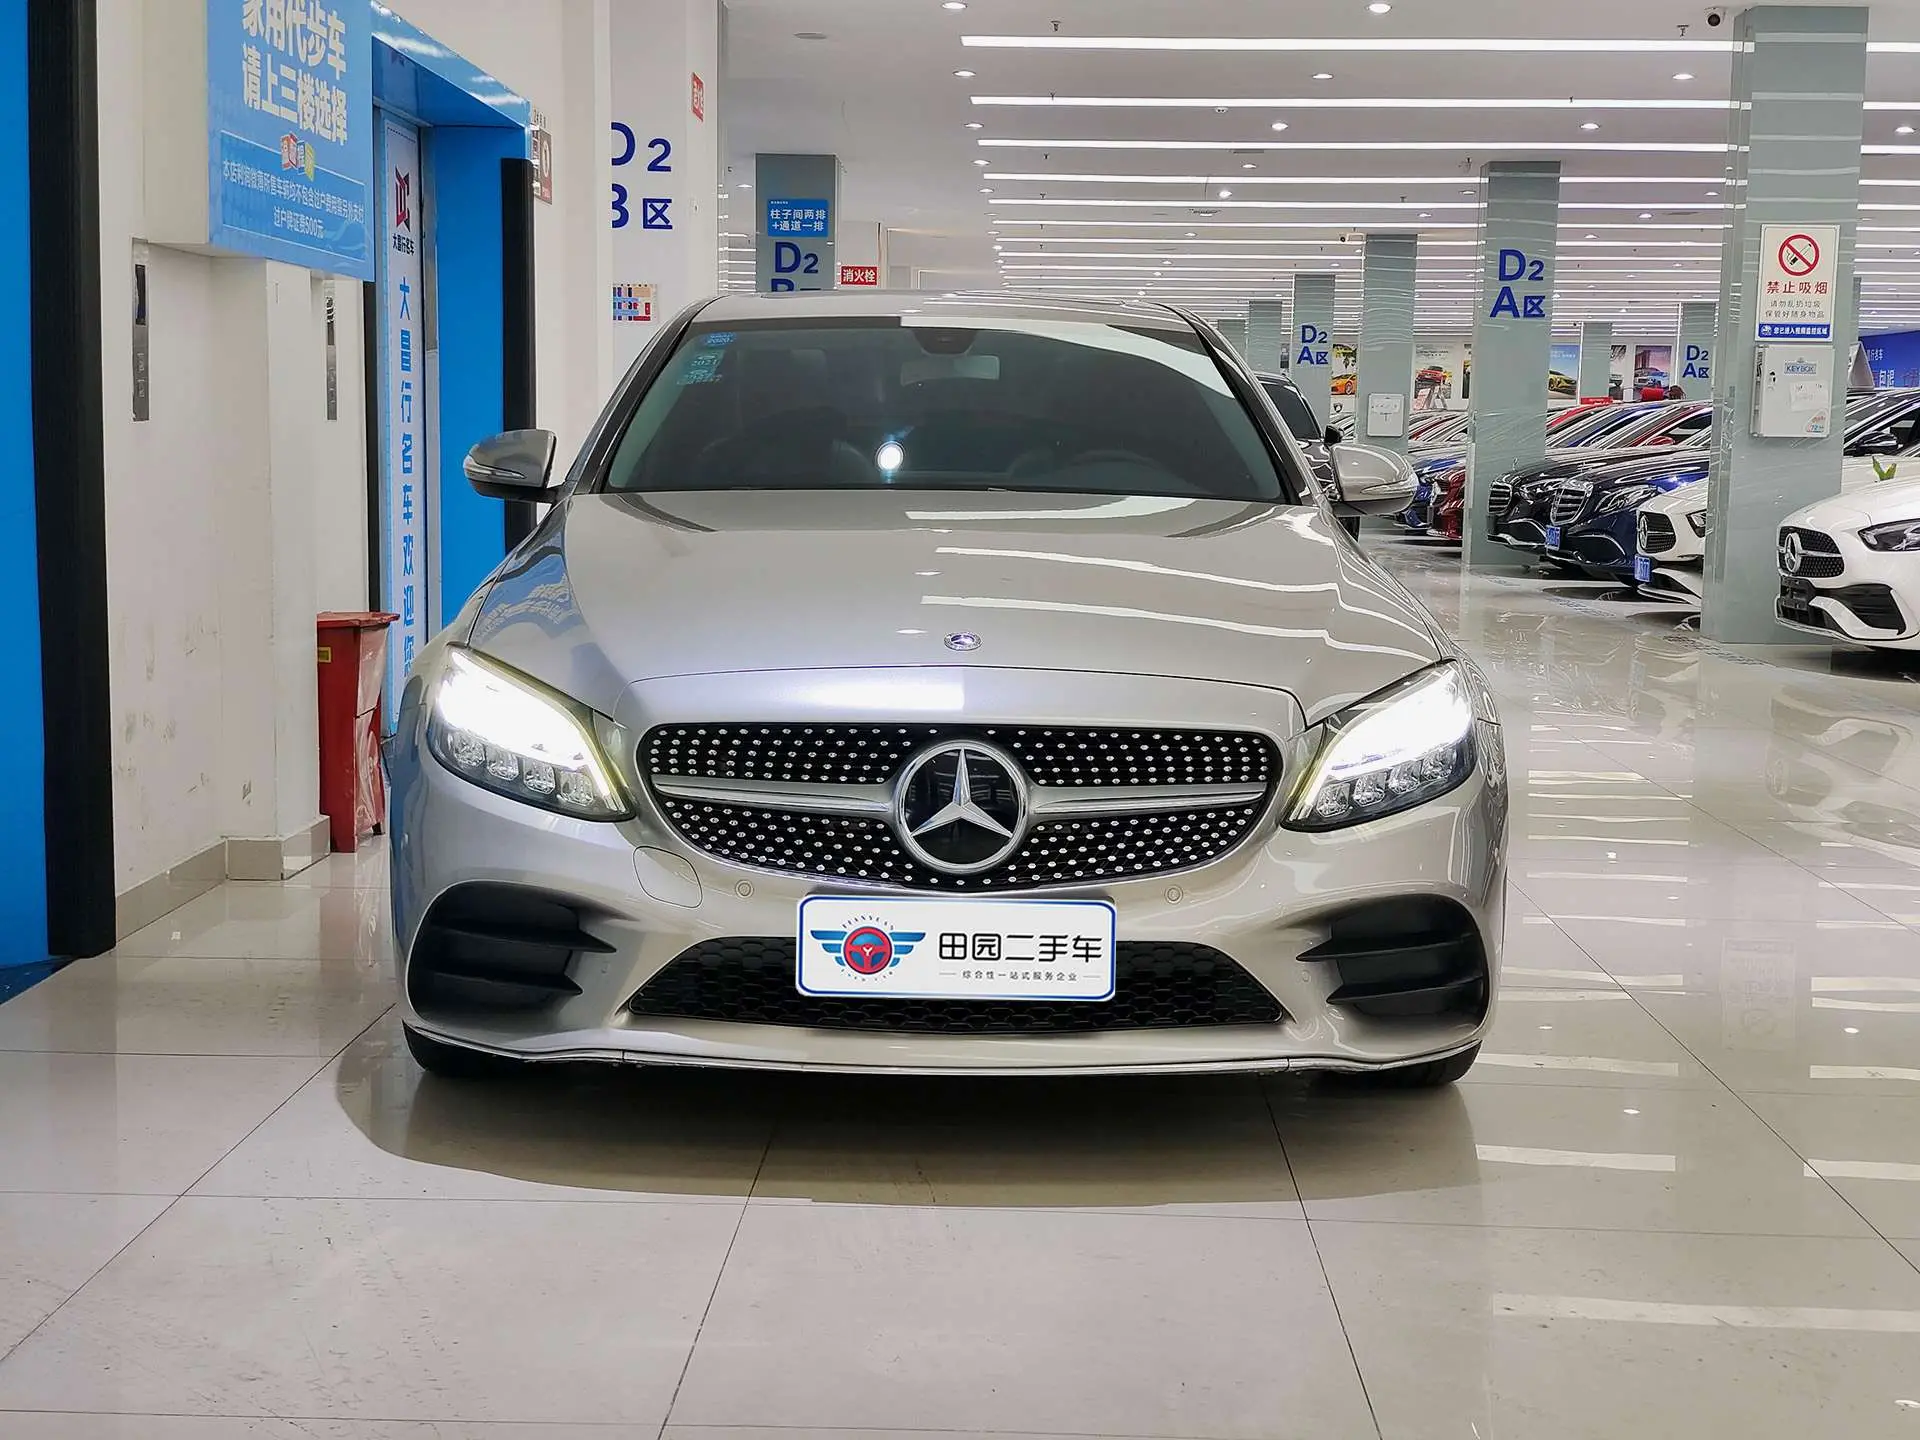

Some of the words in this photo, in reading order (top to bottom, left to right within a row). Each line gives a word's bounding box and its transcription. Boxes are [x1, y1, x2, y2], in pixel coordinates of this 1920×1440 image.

[242, 42, 347, 146] 请上三楼选择
[770, 209, 826, 220] 柱子间两排
[772, 220, 824, 232] +通道一排
[774, 241, 819, 274] D2
[1499, 248, 1544, 281] D2
[842, 269, 876, 283] 消火栓
[1766, 281, 1828, 295] 禁止吸烟
[1489, 286, 1546, 318] A区
[1301, 325, 1329, 344] D2
[1296, 346, 1329, 365] A区
[1686, 345, 1709, 361] D2
[1682, 363, 1710, 378] A区
[939, 932, 1103, 963] 田园二手车
[962, 970, 1078, 982] 综合性一站式服务企业
